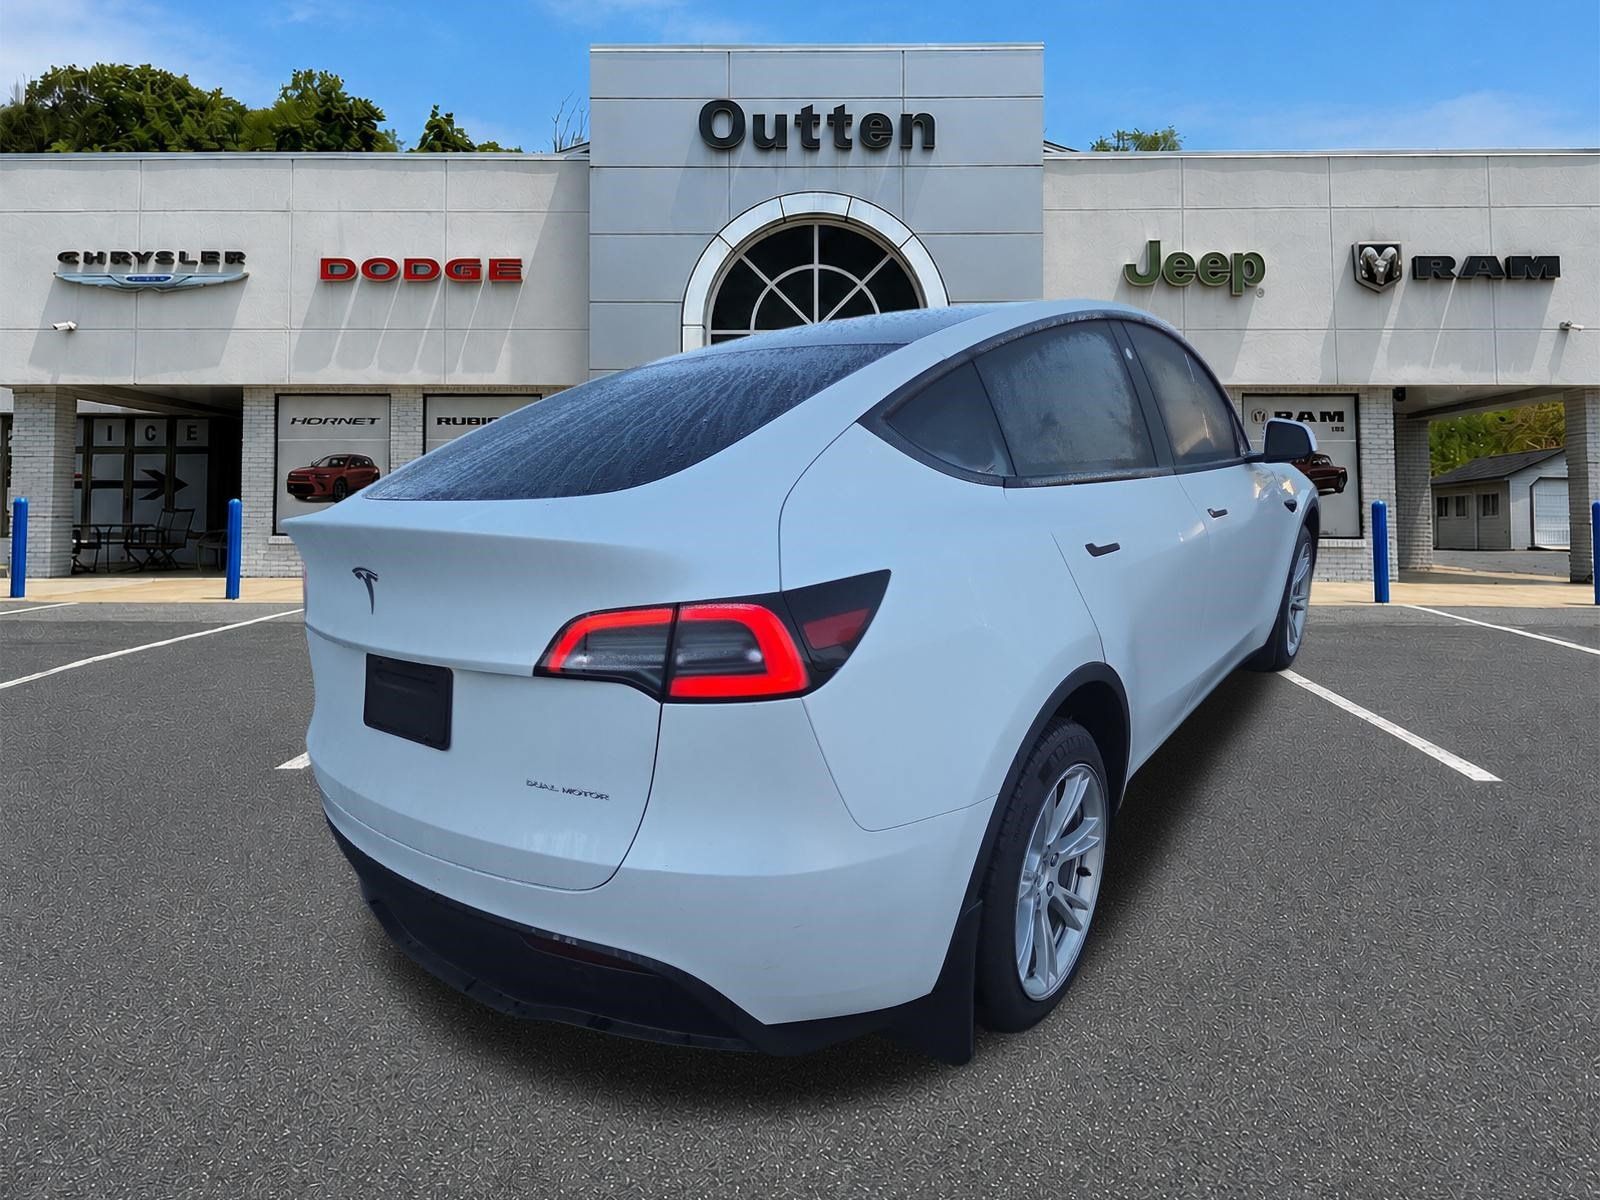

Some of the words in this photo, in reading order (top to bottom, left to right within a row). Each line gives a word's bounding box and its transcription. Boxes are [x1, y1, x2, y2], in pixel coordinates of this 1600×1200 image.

[698, 99, 936, 150] Outten
[57, 251, 247, 265] CHRYSLER
[1124, 239, 1266, 296] Jeep
[1412, 255, 1561, 280] RAM
[320, 257, 523, 283] DODGE
[290, 417, 381, 426] HORNET
[1274, 411, 1345, 423] RAM
[526, 780, 560, 792] DUAL
[562, 786, 610, 801] MOTOR
